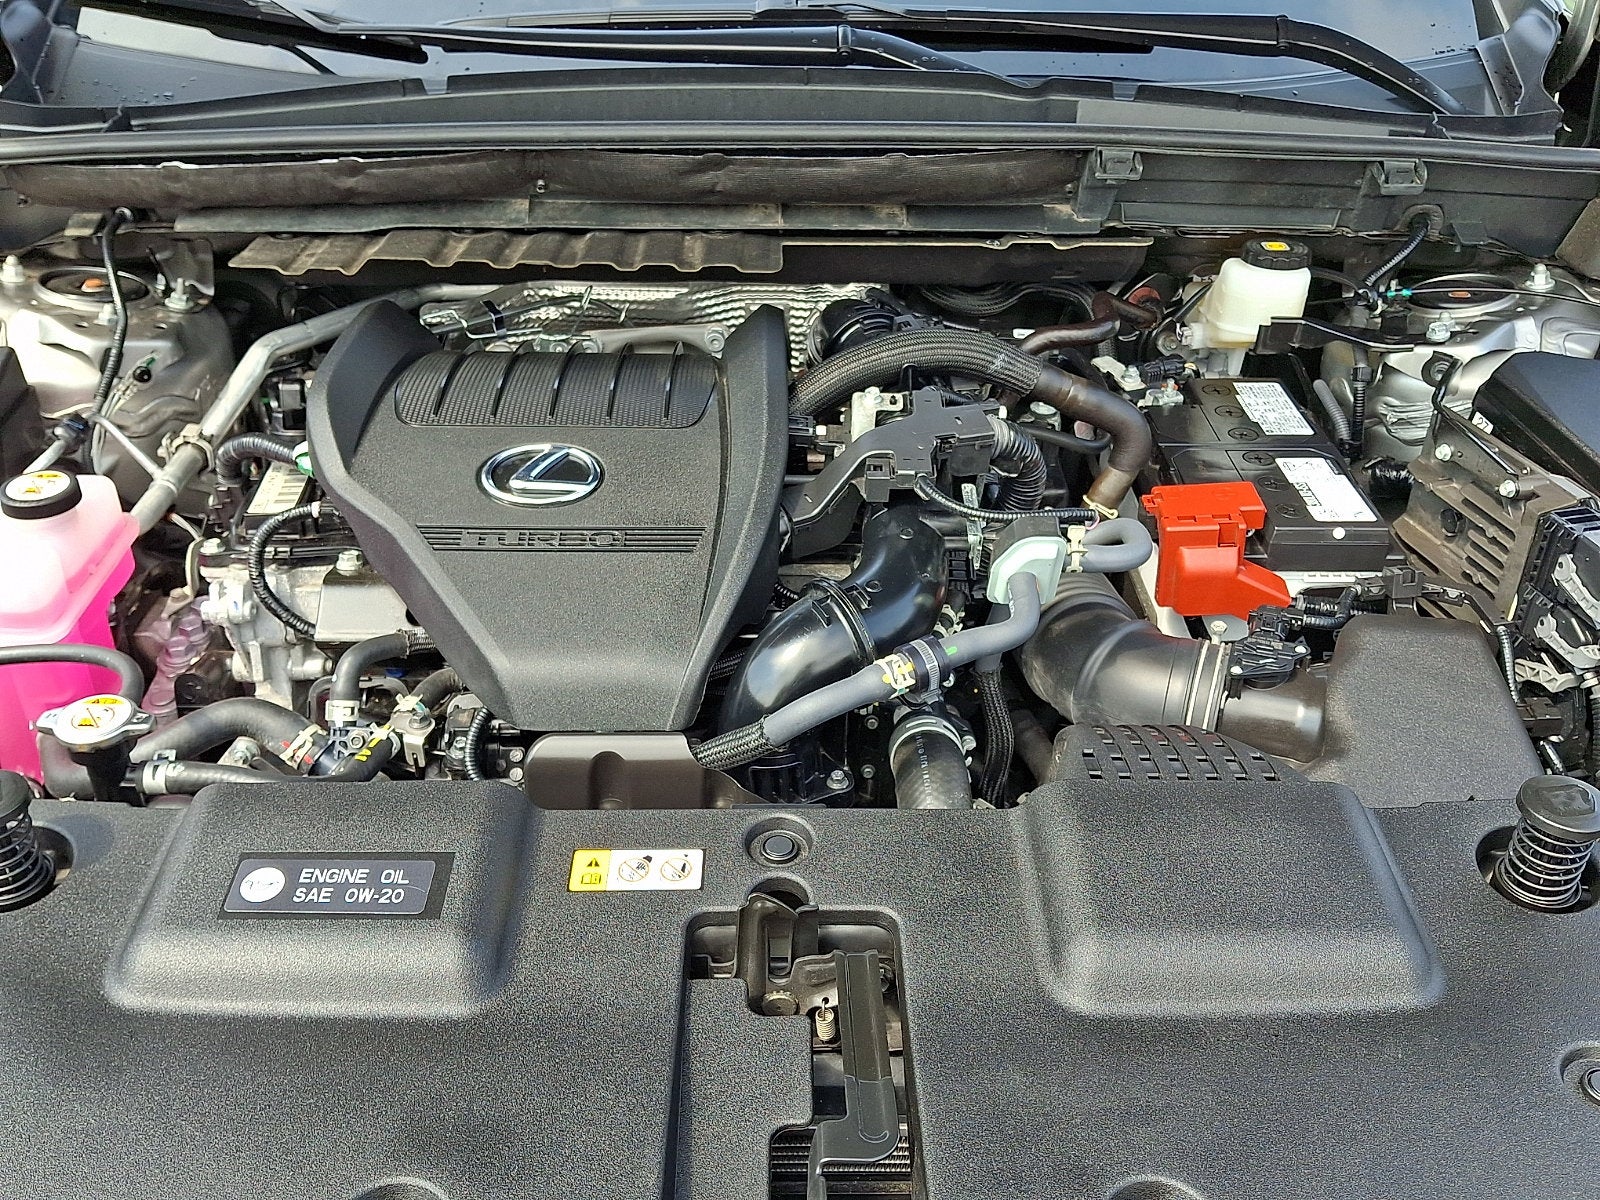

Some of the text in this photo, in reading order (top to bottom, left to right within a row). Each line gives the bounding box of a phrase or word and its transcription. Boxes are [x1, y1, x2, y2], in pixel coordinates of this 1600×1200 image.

[464, 529, 624, 547] TURBO
[299, 869, 410, 884] ENGINE OIL
[292, 887, 405, 904] SAE 0W-20
